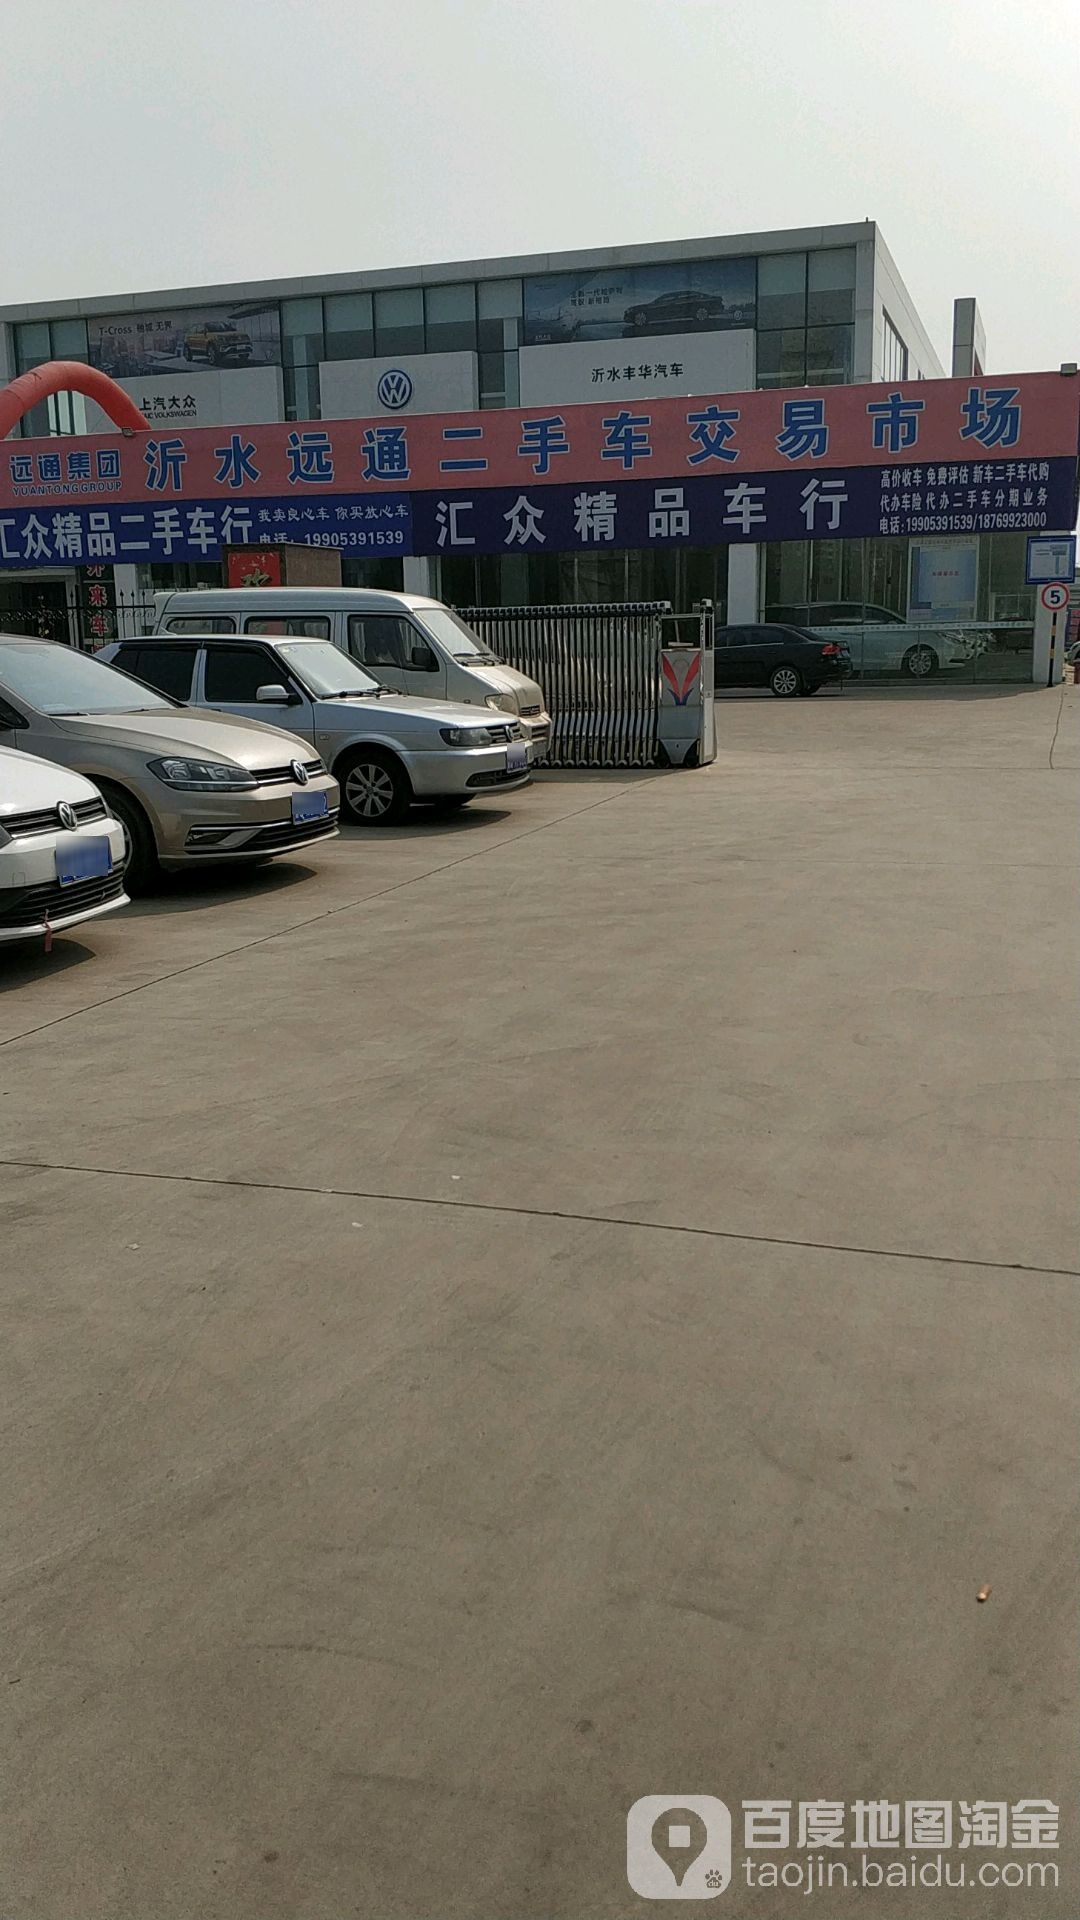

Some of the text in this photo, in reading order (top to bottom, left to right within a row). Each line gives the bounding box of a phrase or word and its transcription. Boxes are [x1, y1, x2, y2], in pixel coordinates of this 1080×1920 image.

[99, 326, 132, 335] T-Cross
[591, 362, 684, 382] 沂水丰华汽车
[139, 394, 196, 411] 上汽大众
[155, 409, 197, 418] VOLKSWAGEN
[144, 387, 1021, 492] 沂水远通二手车交易市场
[9, 448, 121, 484] 远通集团
[880, 461, 1050, 489] 高价收车 免费评估 新车二手车代购
[880, 492, 922, 513] 代办车险
[258, 503, 409, 523] 我卖良心车 你买放心车
[435, 478, 848, 549] 汇众精品车行
[304, 530, 404, 547] 19905391539
[1050, 589, 1061, 605] 5
